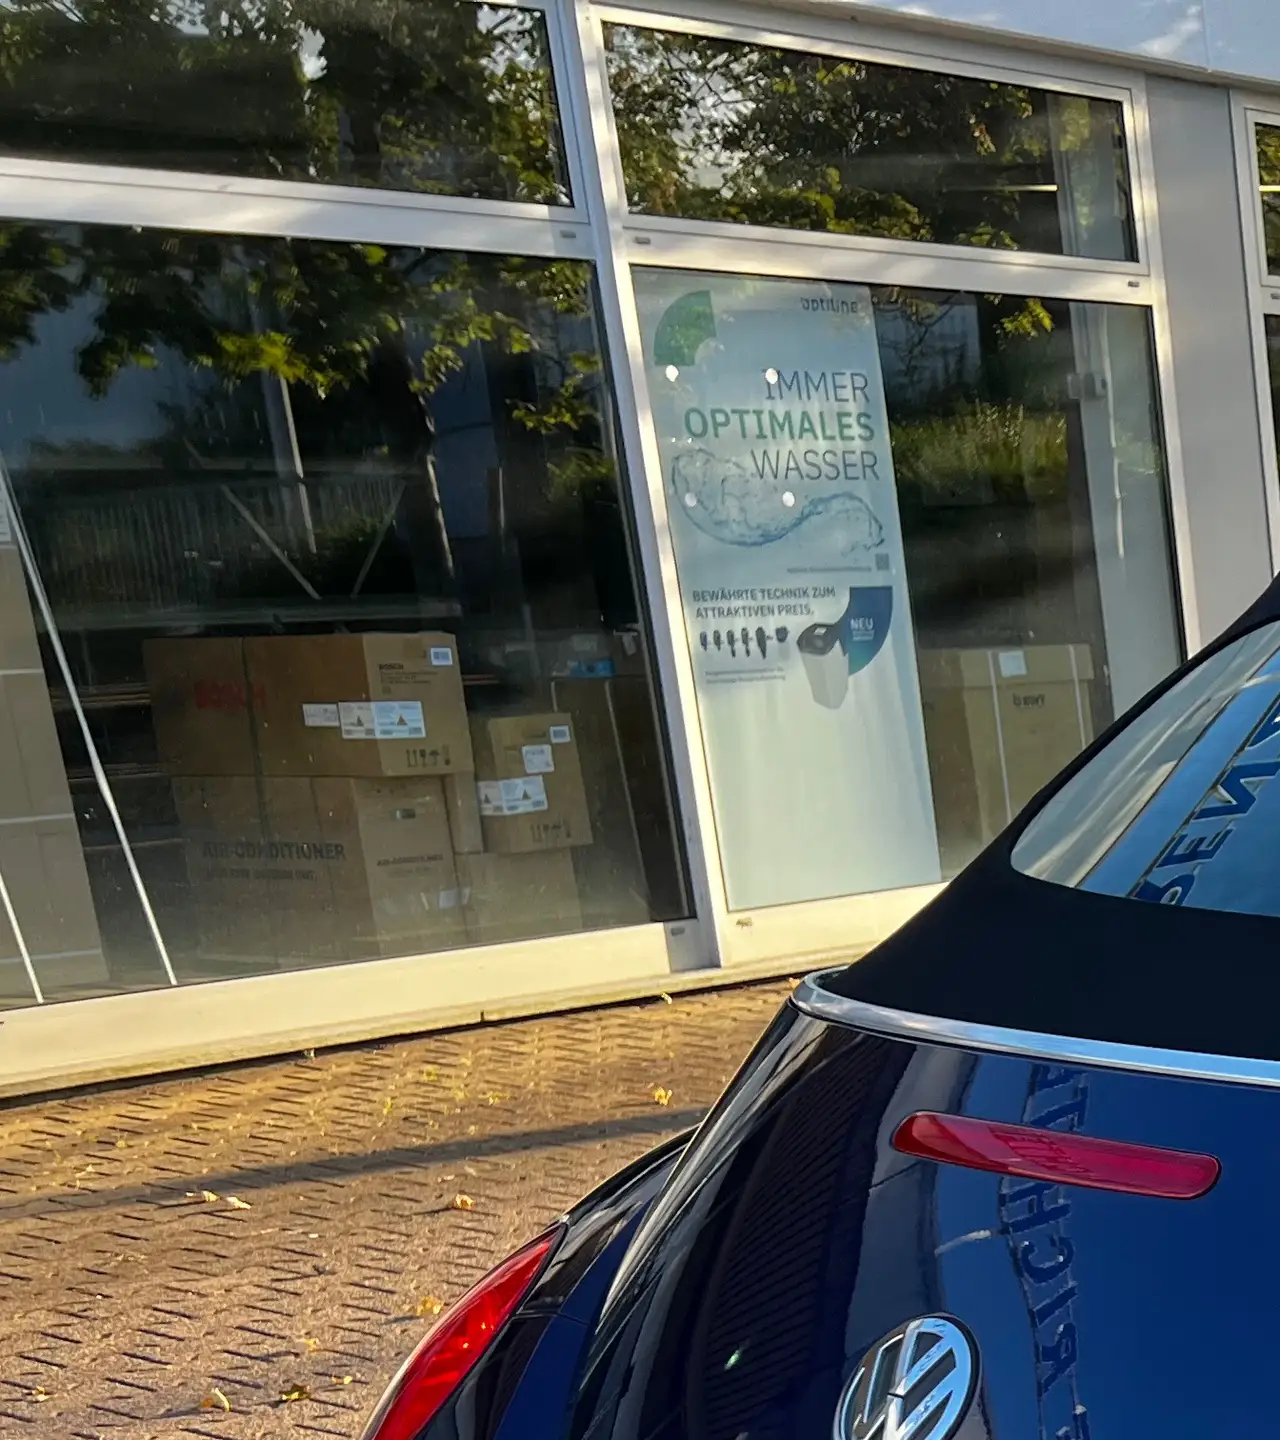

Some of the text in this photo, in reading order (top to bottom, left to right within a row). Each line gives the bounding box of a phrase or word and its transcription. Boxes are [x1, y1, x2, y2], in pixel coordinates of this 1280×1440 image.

[764, 368, 870, 404] IMMER
[684, 406, 876, 442] OPTIMALES
[750, 448, 881, 482] WASSER
[692, 585, 837, 602] BEWÄHRTE TECHNIK ZUM
[695, 604, 775, 619] ATTRAKTIVEN
[850, 617, 874, 630] NEU
